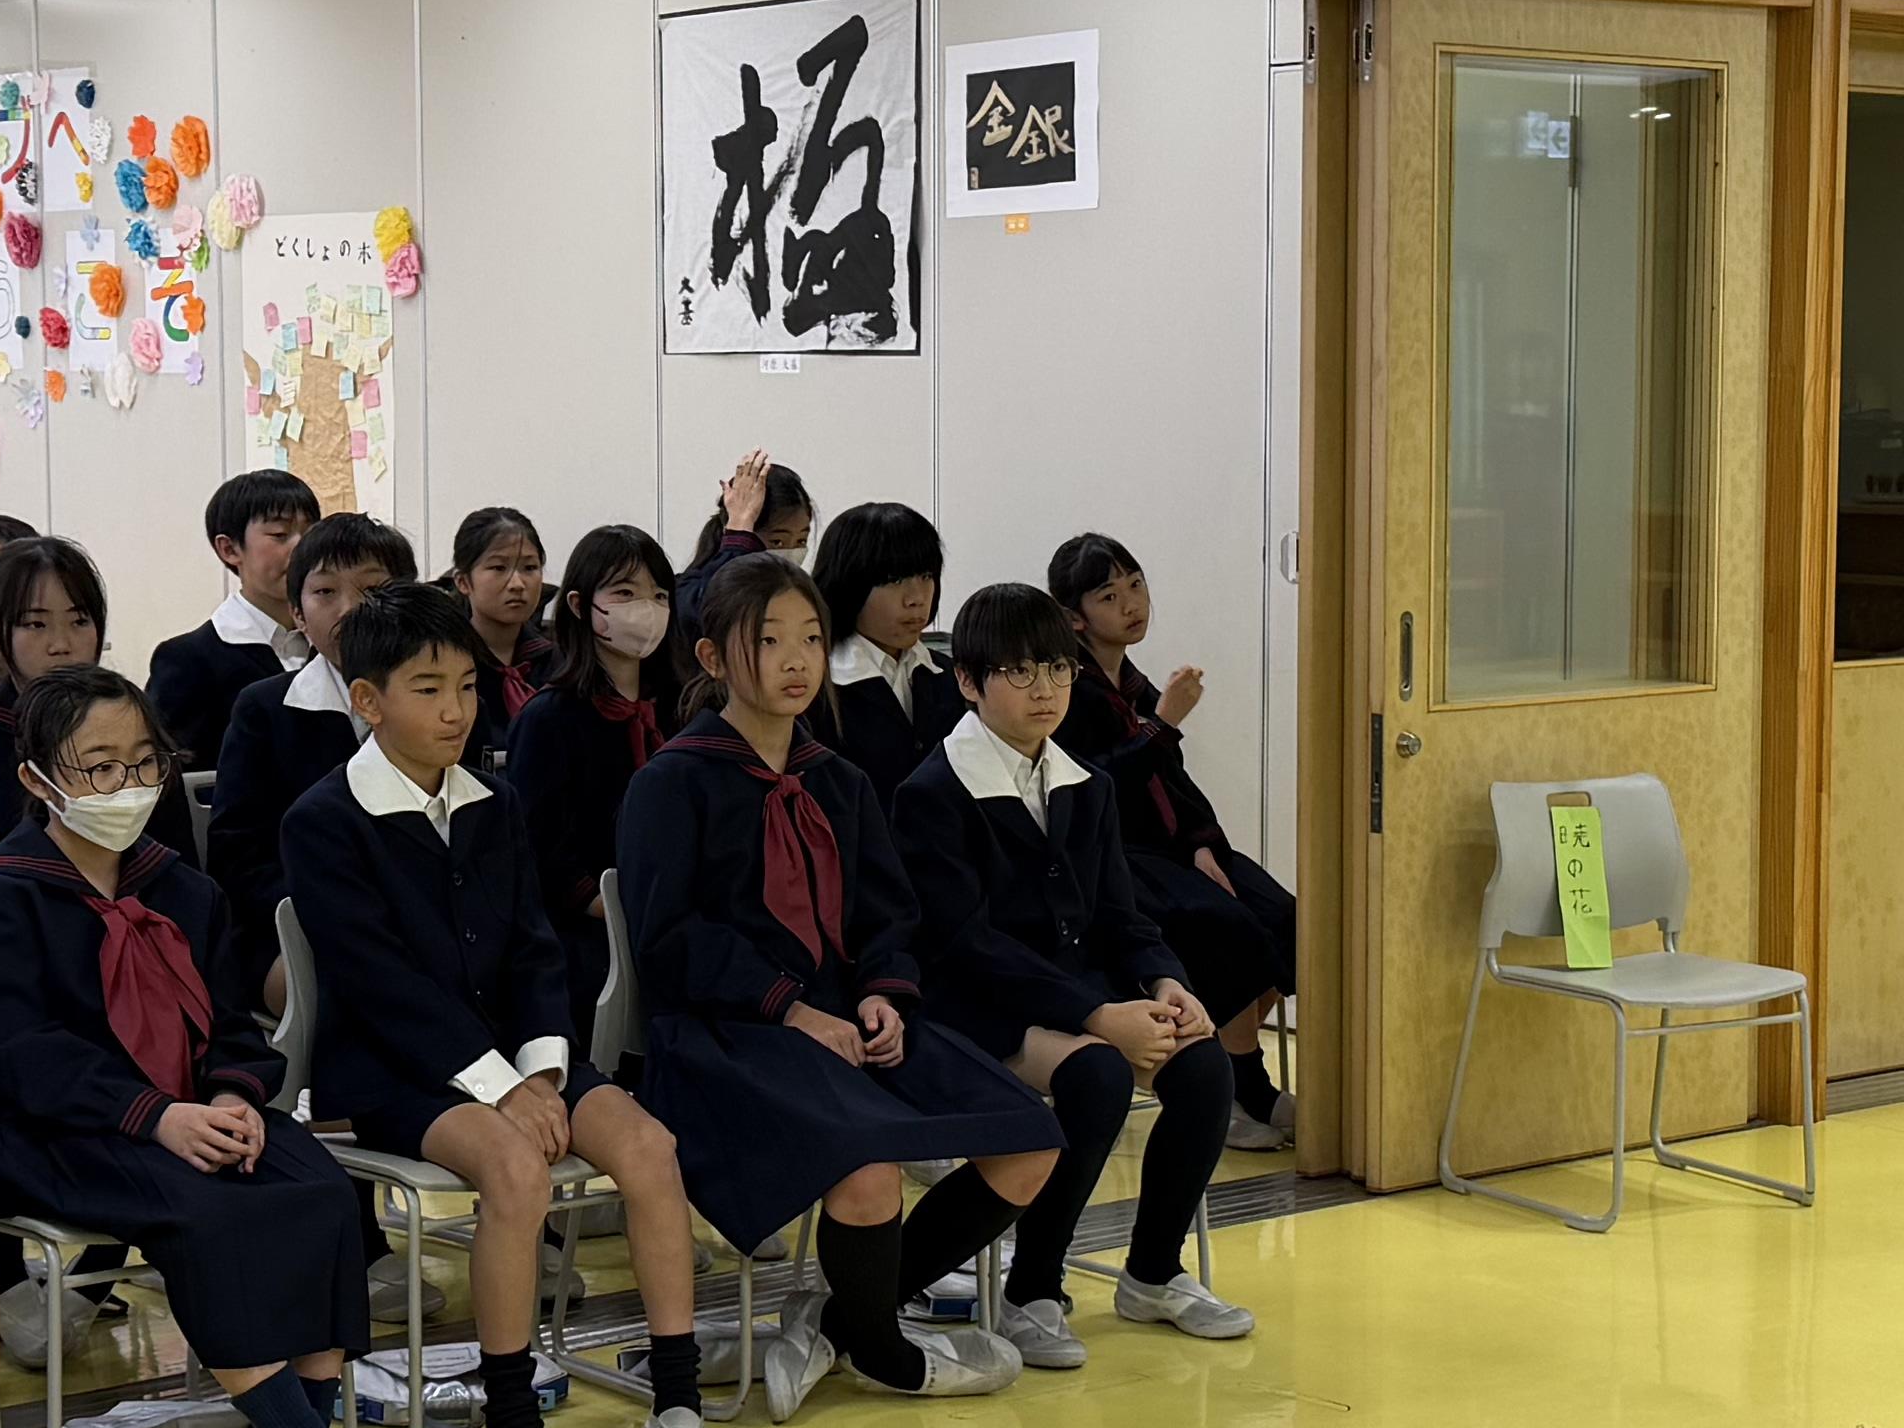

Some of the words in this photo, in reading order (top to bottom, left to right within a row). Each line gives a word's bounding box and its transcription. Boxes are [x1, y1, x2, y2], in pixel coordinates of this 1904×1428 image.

[966, 80, 1076, 165] 金銀
[275, 236, 372, 265] どくしょの木
[1559, 824, 1592, 914] 暁の花
